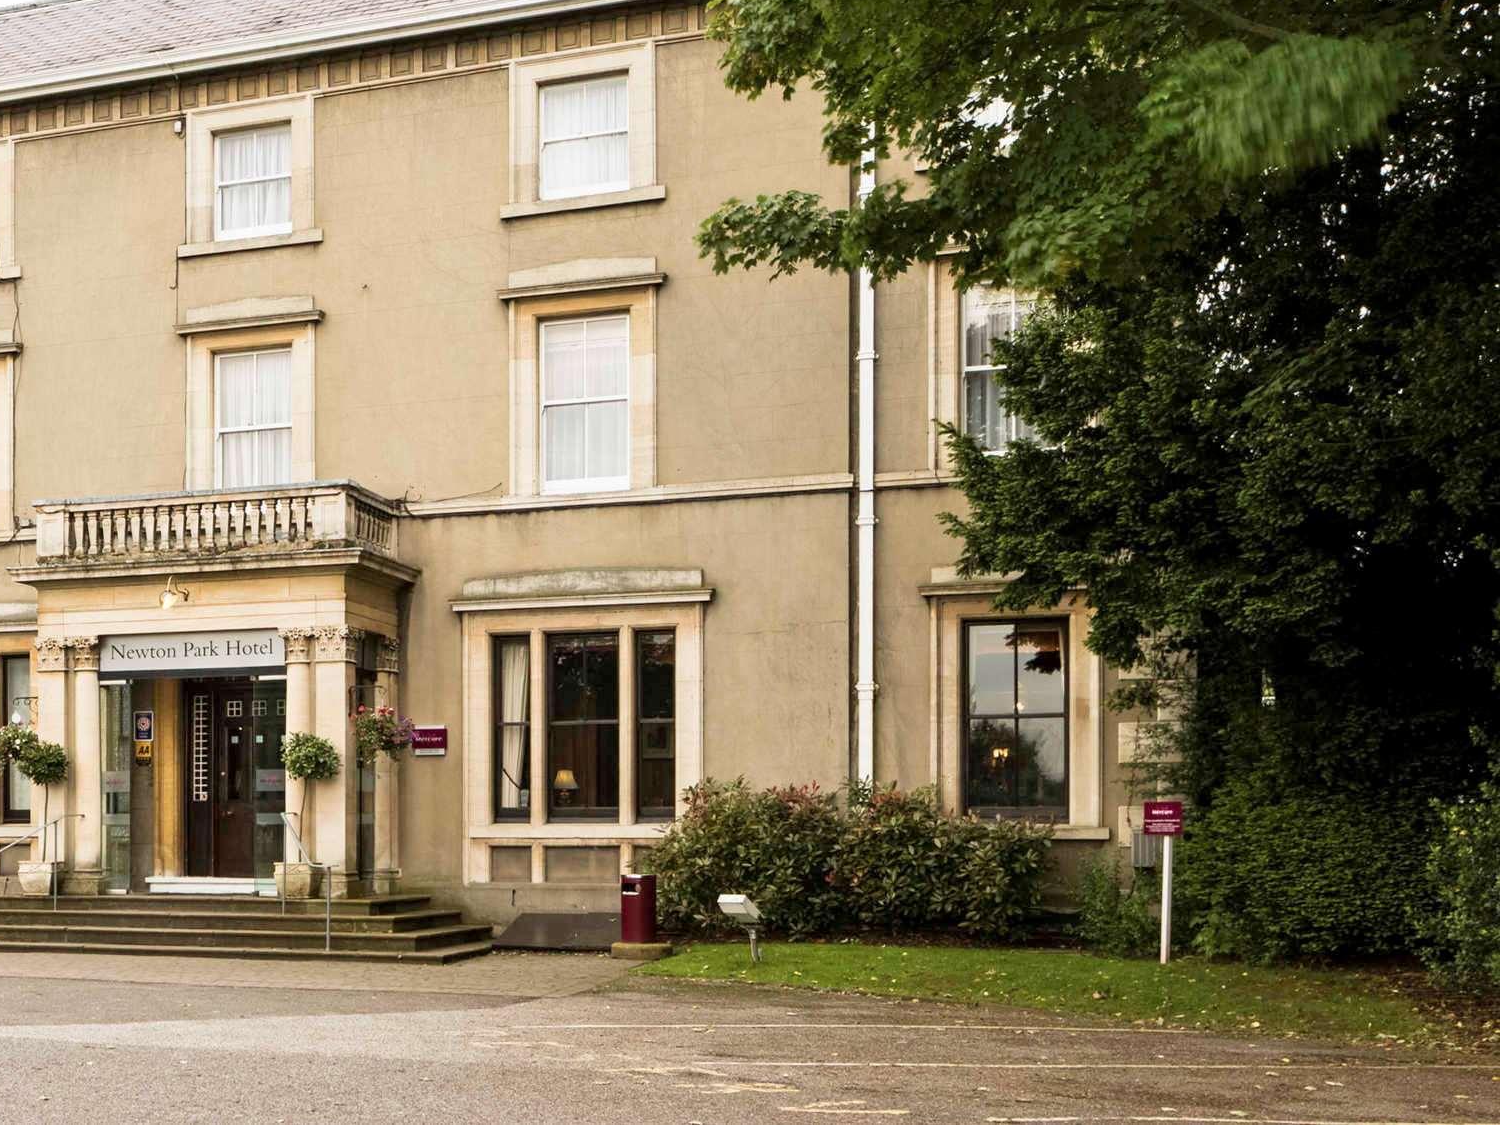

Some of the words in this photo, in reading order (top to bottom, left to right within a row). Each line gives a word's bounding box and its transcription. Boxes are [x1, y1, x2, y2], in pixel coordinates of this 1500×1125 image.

[110, 644, 177, 660] Newton
[184, 640, 219, 658] Park
[226, 638, 274, 656] Hotel
[138, 745, 150, 755] AA
